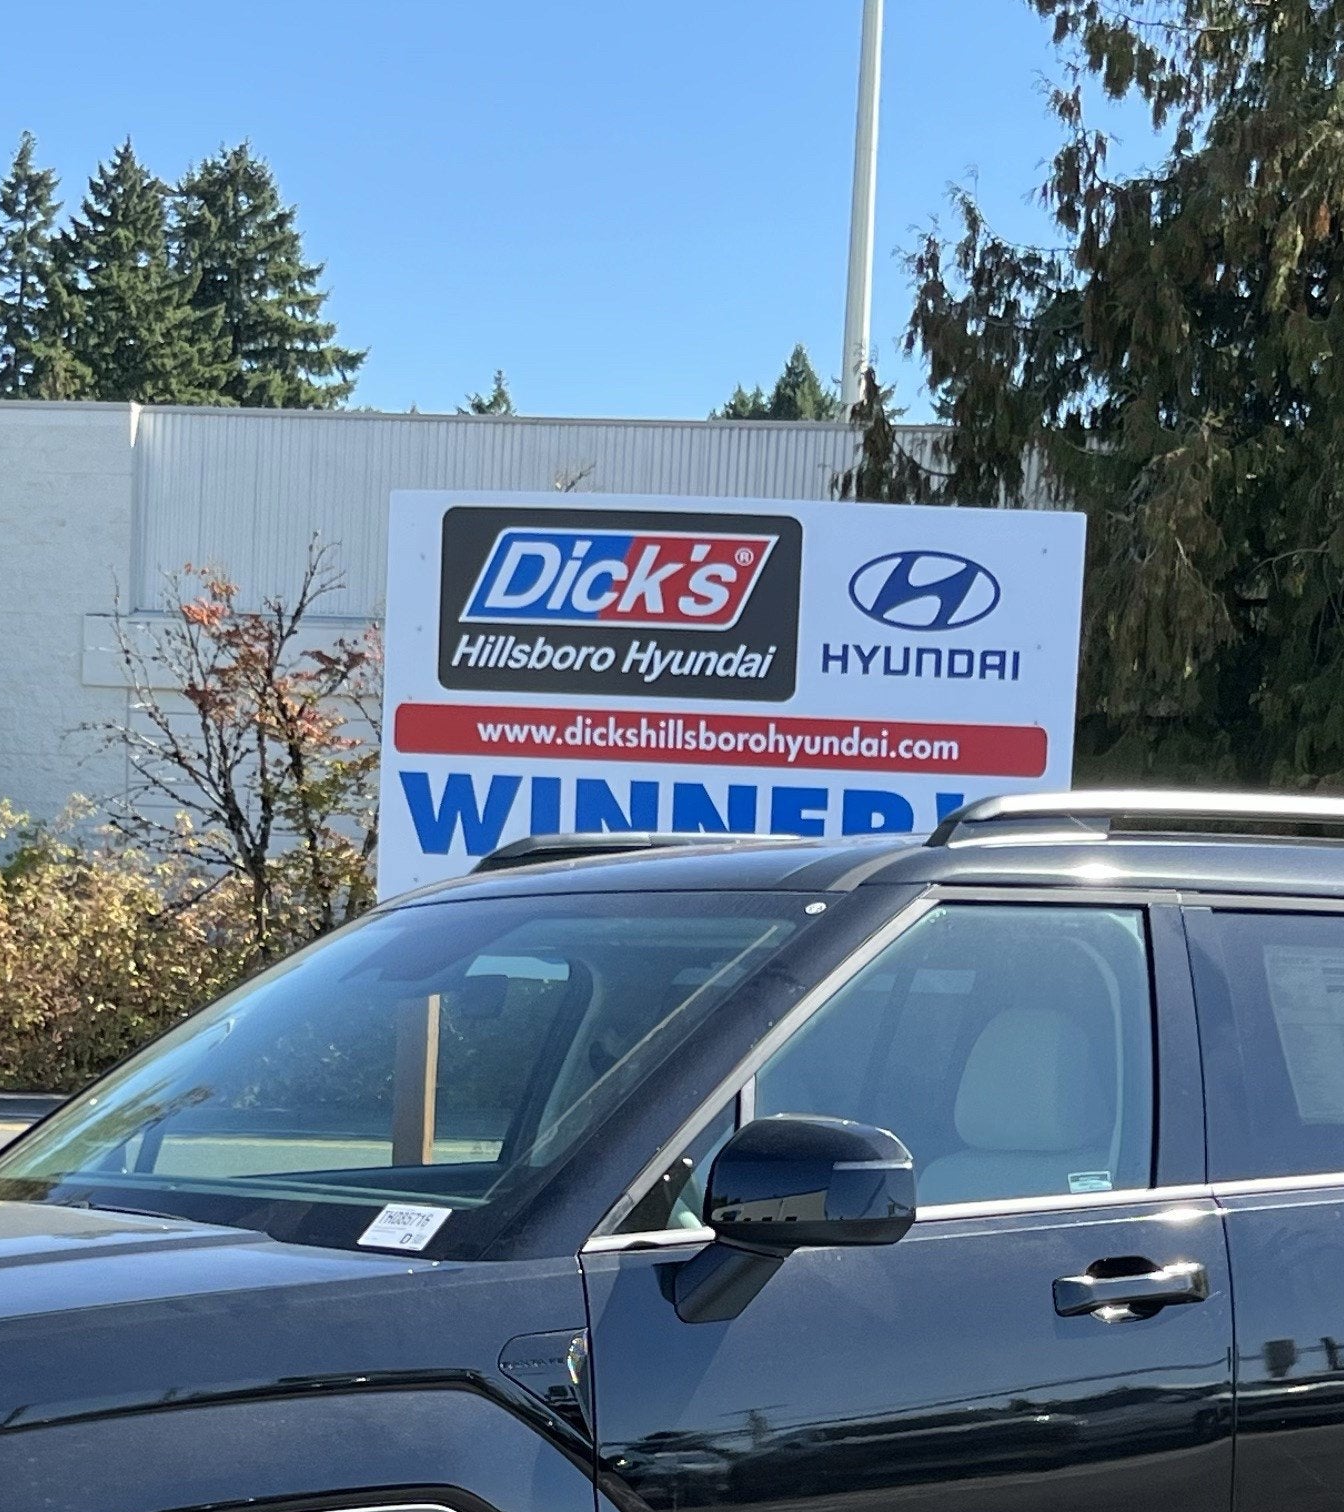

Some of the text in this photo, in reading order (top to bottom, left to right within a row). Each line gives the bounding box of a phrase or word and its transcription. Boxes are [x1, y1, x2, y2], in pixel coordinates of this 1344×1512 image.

[451, 633, 778, 682] Hillsboro Hyundai
[822, 643, 1021, 682] HYUNDAI
[476, 716, 959, 762] www.dickshillsborohyundai.com
